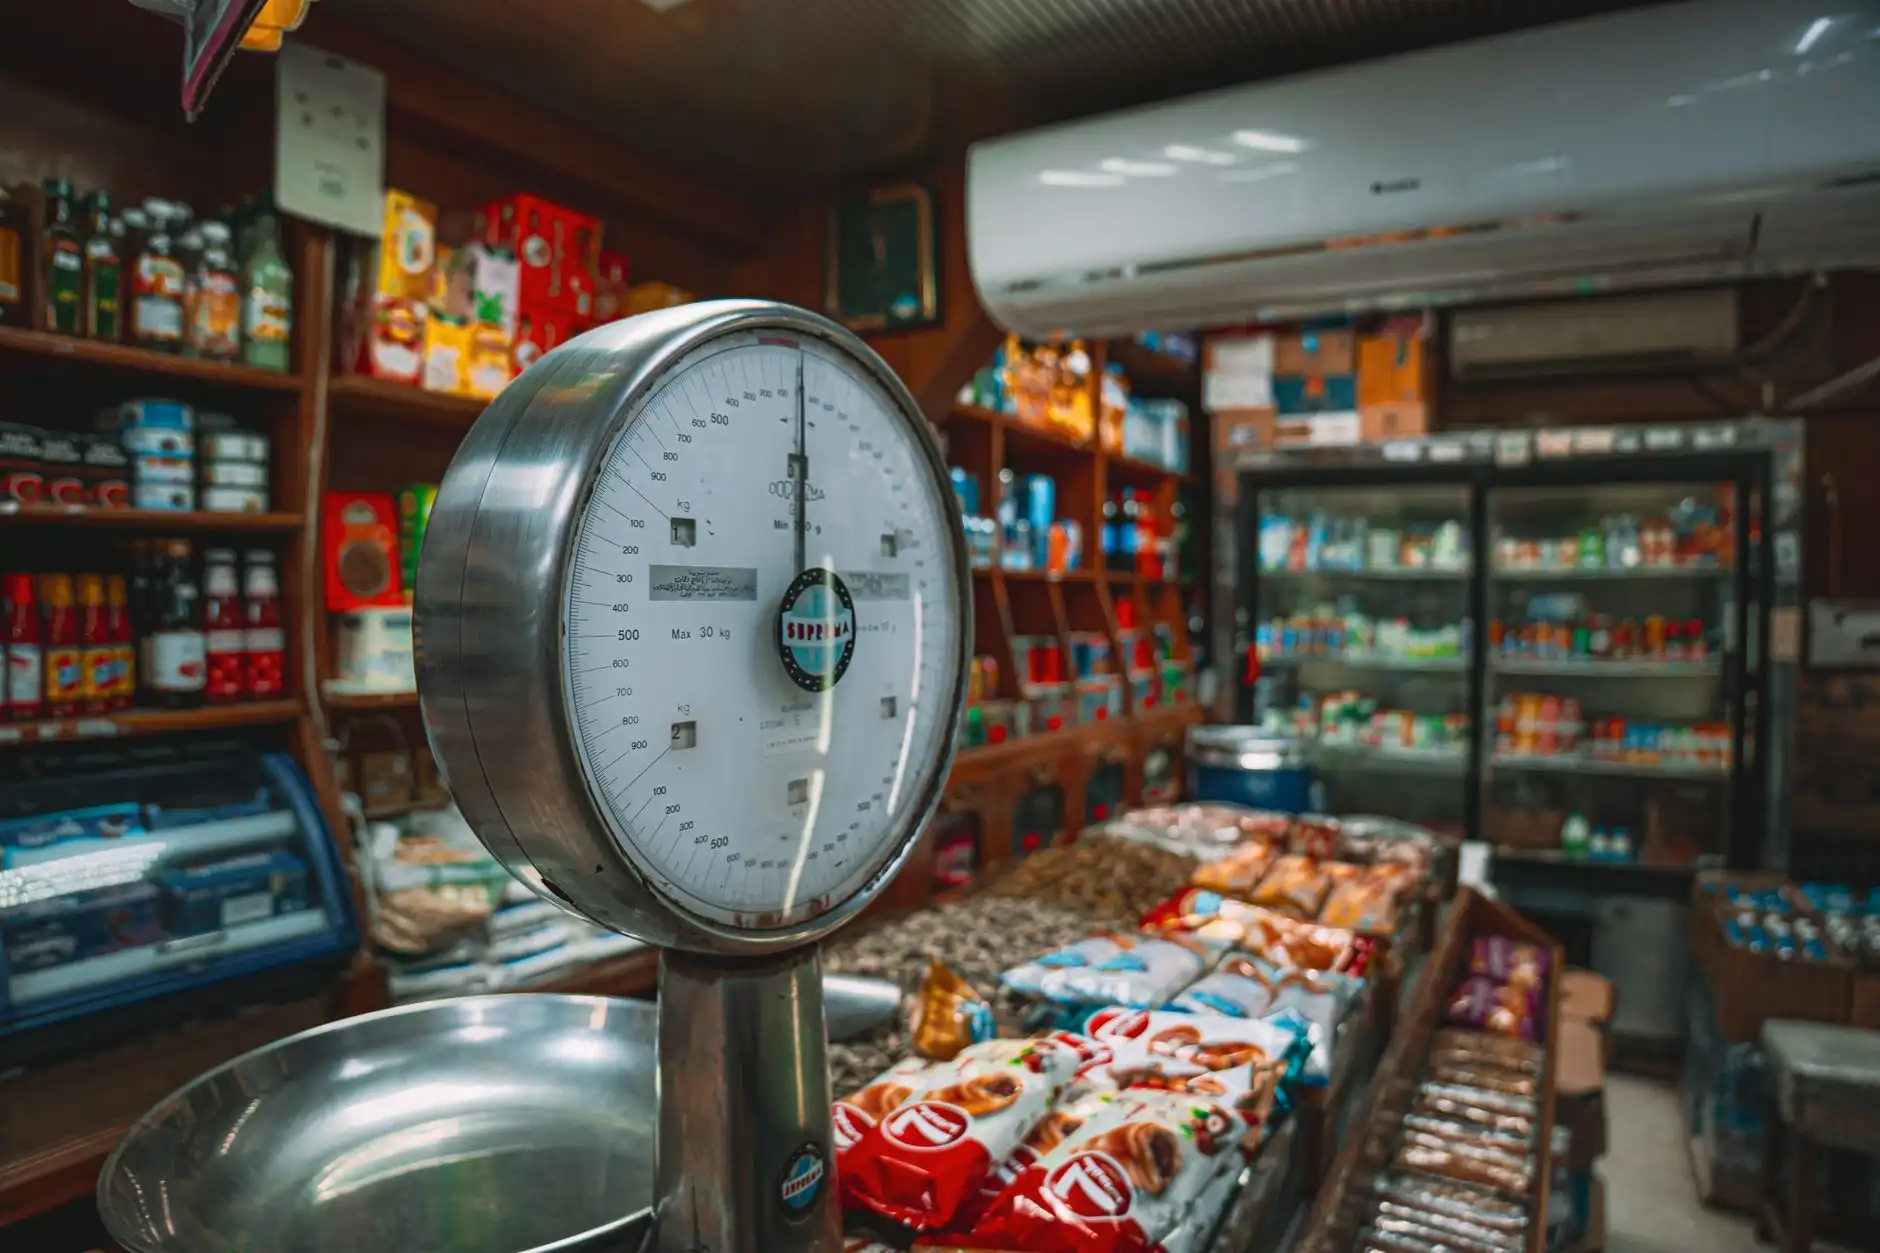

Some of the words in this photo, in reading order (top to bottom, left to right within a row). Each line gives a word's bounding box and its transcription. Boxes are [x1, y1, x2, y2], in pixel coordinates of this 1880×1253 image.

[725, 397, 740, 407] 400
[691, 418, 707, 428] 600
[710, 412, 729, 426] 500
[677, 433, 692, 444] 700
[663, 451, 679, 462] 800
[650, 471, 667, 482] 900
[677, 498, 691, 513] kg
[630, 519, 645, 529] 100
[622, 545, 639, 555] 200
[616, 574, 633, 583] 300
[612, 603, 629, 612] 400
[617, 629, 640, 641] 500
[671, 628, 692, 640] Max
[700, 626, 714, 638] 30
[719, 627, 731, 640] kg
[612, 659, 630, 668] 600
[616, 687, 633, 697] 700
[677, 703, 691, 716] kg
[622, 715, 640, 726] 800
[671, 723, 681, 740] 2
[631, 740, 648, 751] 900
[652, 785, 667, 796] 100
[664, 804, 681, 815] 200
[679, 820, 694, 831] 300
[694, 834, 709, 844] 400
[710, 835, 729, 850] 500
[726, 852, 741, 863] 600
